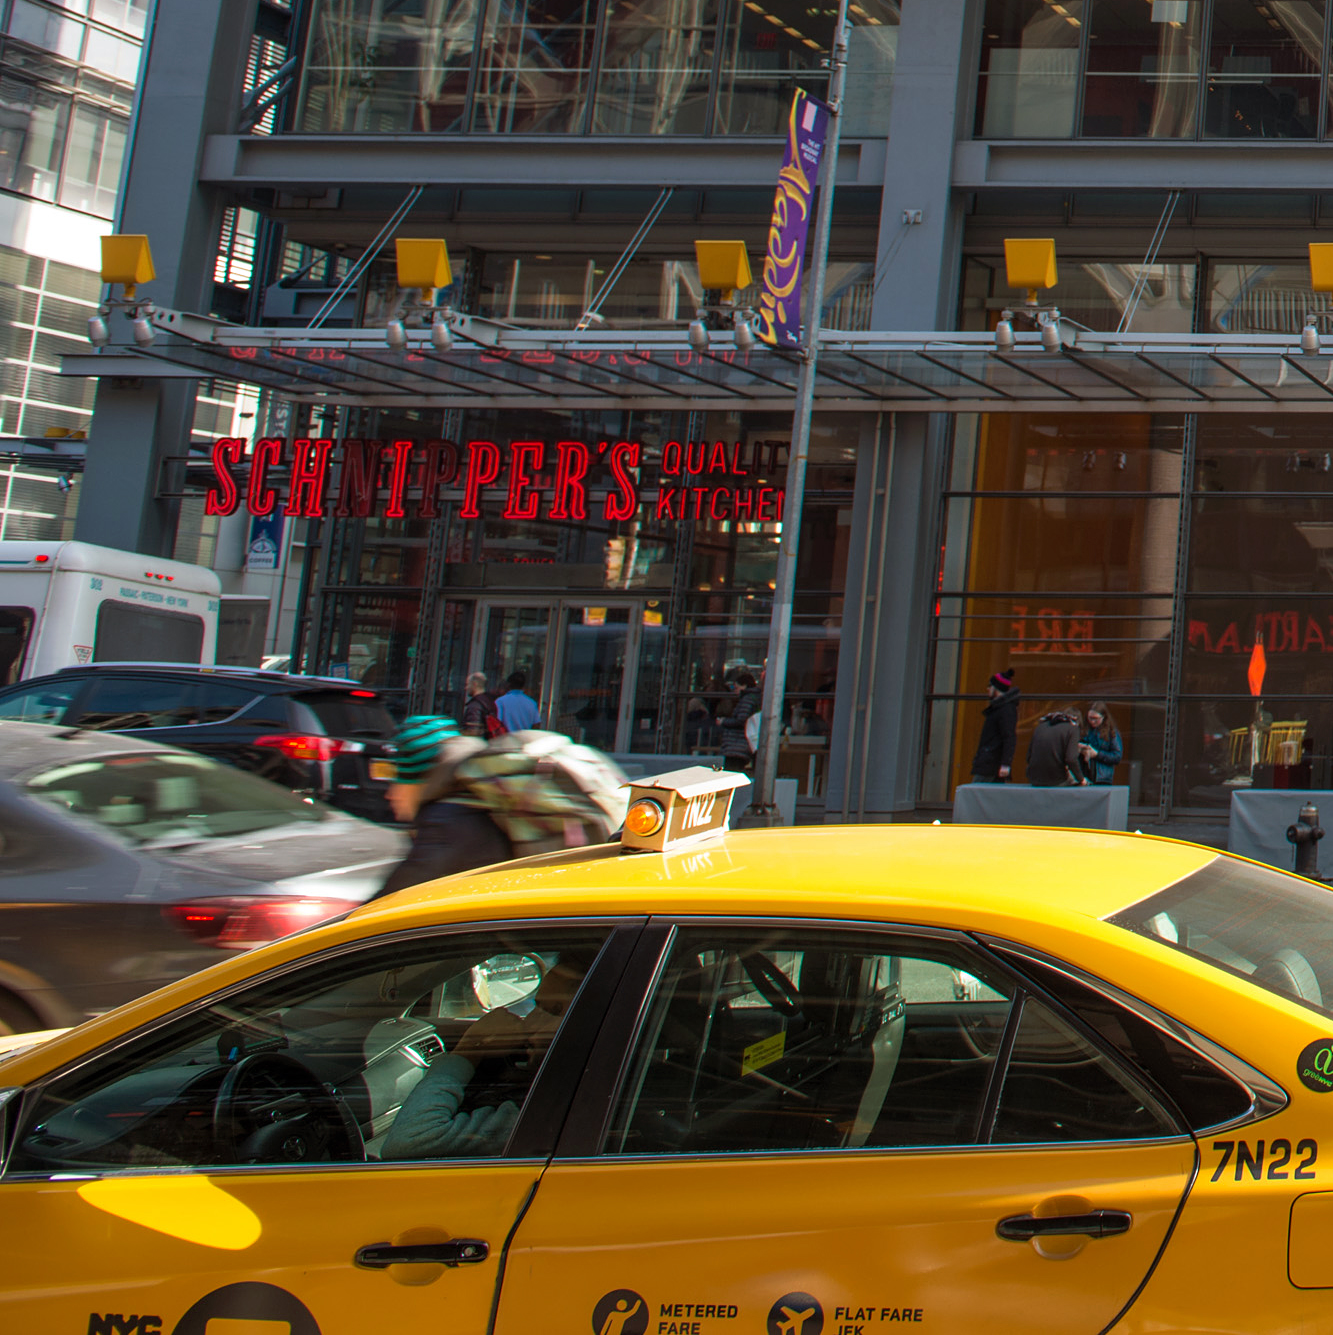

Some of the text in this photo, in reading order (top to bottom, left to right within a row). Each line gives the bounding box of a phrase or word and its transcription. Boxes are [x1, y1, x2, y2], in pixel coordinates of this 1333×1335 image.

[205, 438, 640, 520] SCHNIPPER'S
[1211, 1138, 1318, 1182] 7N22
[659, 1303, 738, 1319] METERED
[834, 1306, 923, 1322] FLAT FARE
[87, 1313, 163, 1335] NYC
[658, 1322, 701, 1335] FARE
[833, 1325, 865, 1335] JFK
